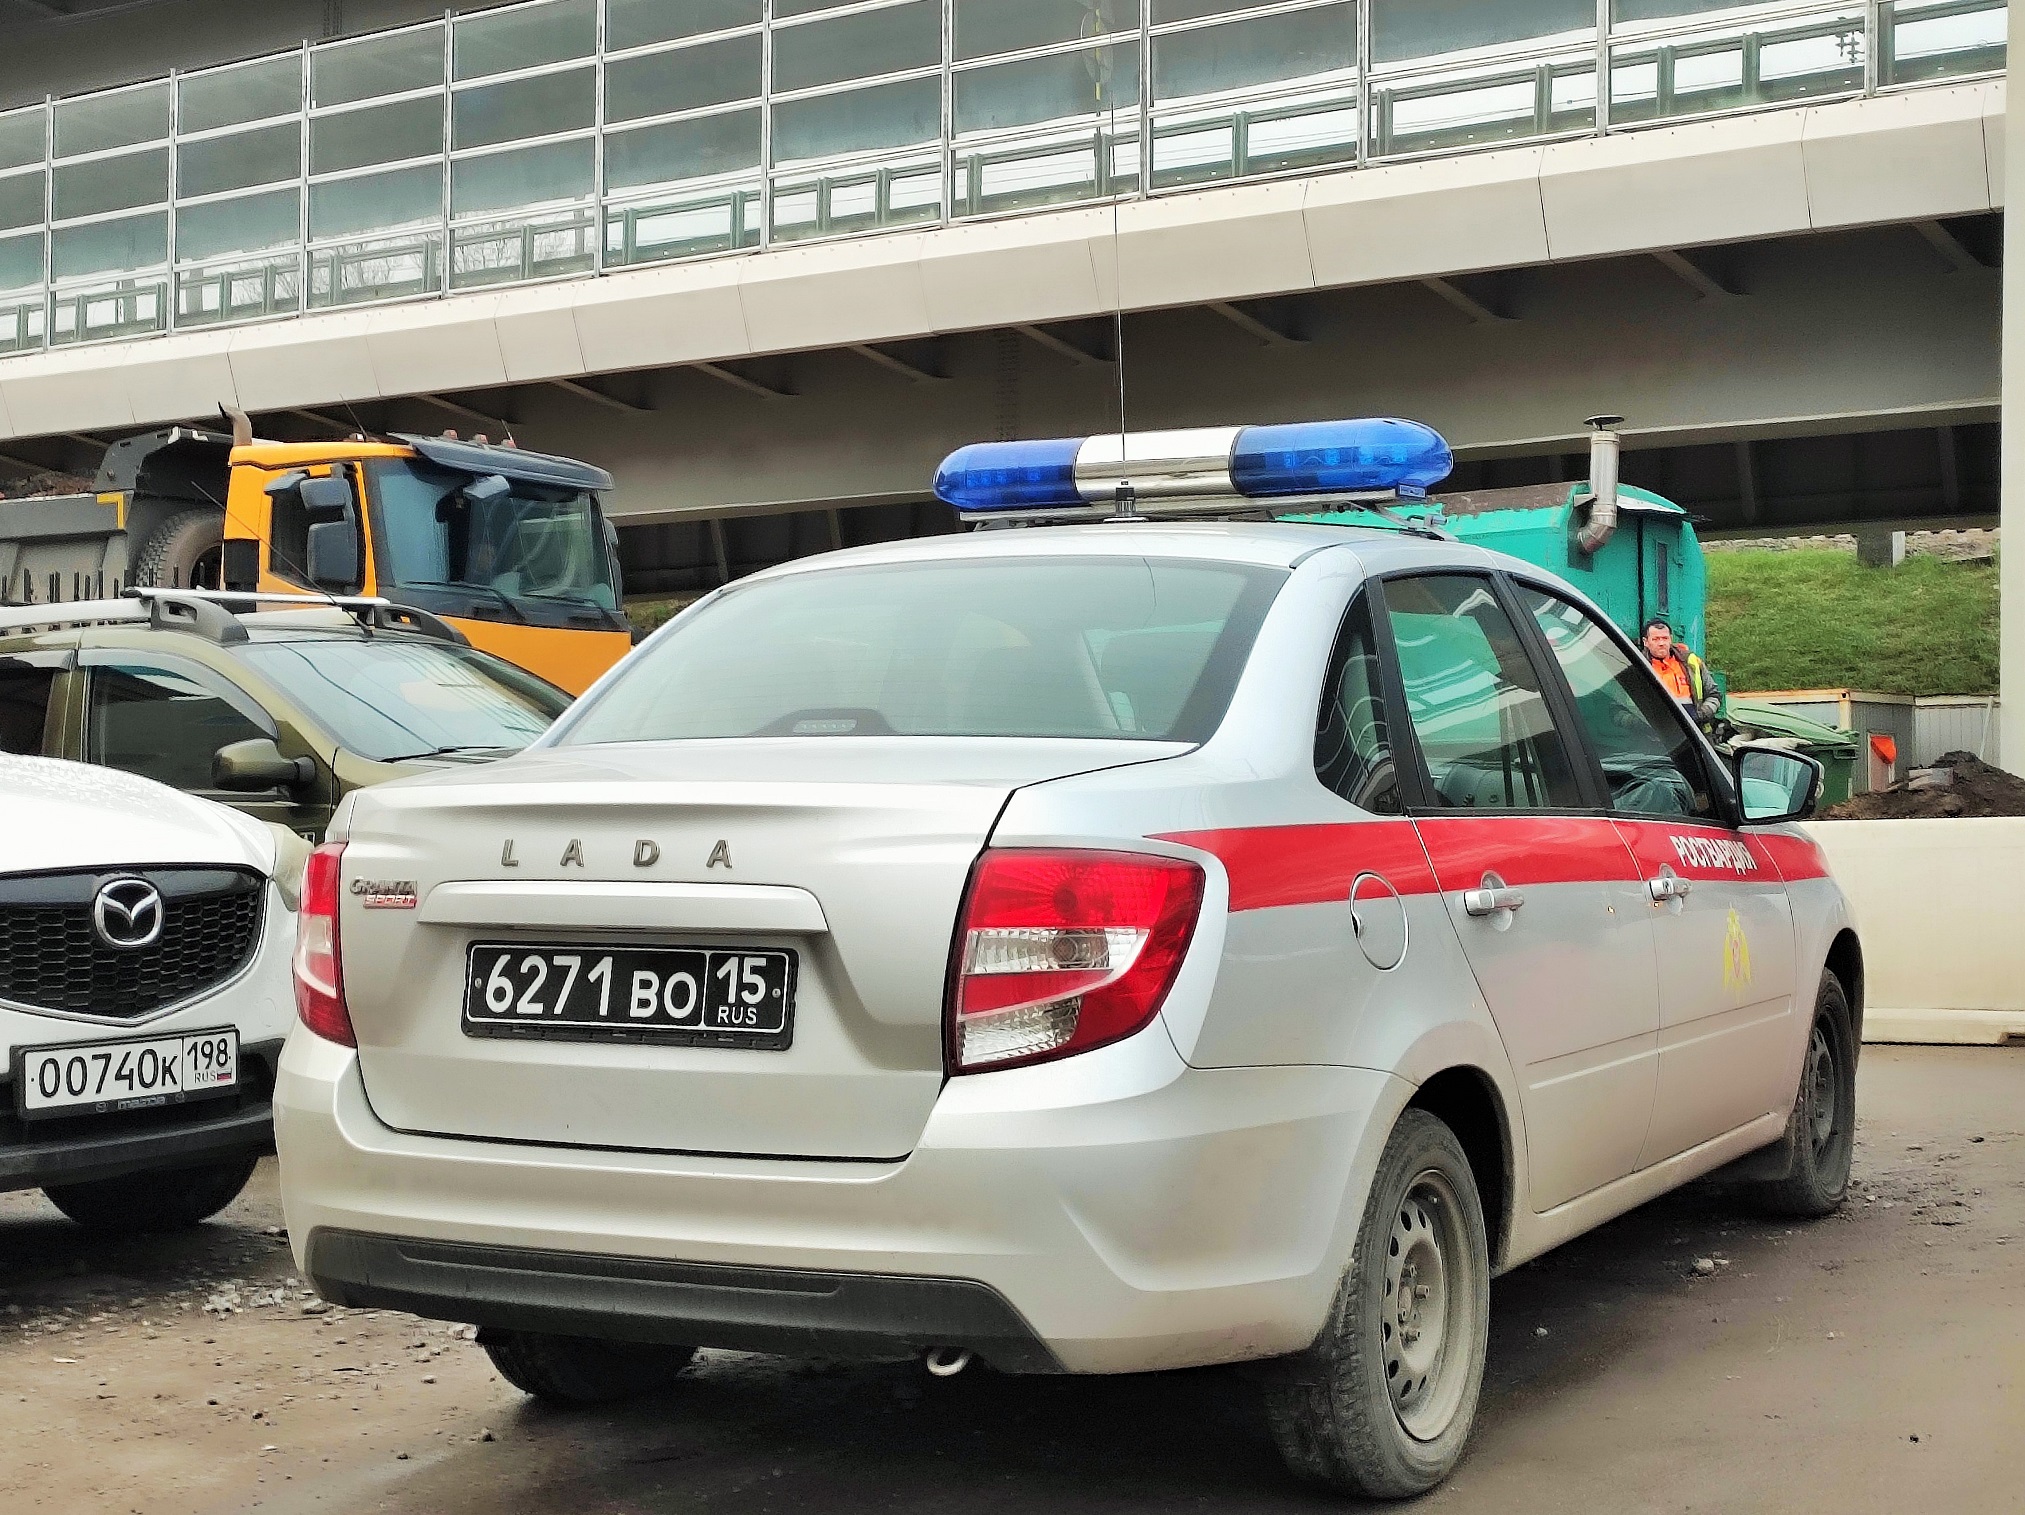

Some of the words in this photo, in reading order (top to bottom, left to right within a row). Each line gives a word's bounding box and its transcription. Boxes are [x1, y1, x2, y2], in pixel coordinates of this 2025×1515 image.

[501, 839, 733, 867] LADA
[485, 954, 613, 1015] 6271
[716, 956, 767, 1004] 15
[717, 1005, 758, 1026] RUS
[186, 1037, 229, 1071] 198
[194, 1070, 216, 1083] RUS
